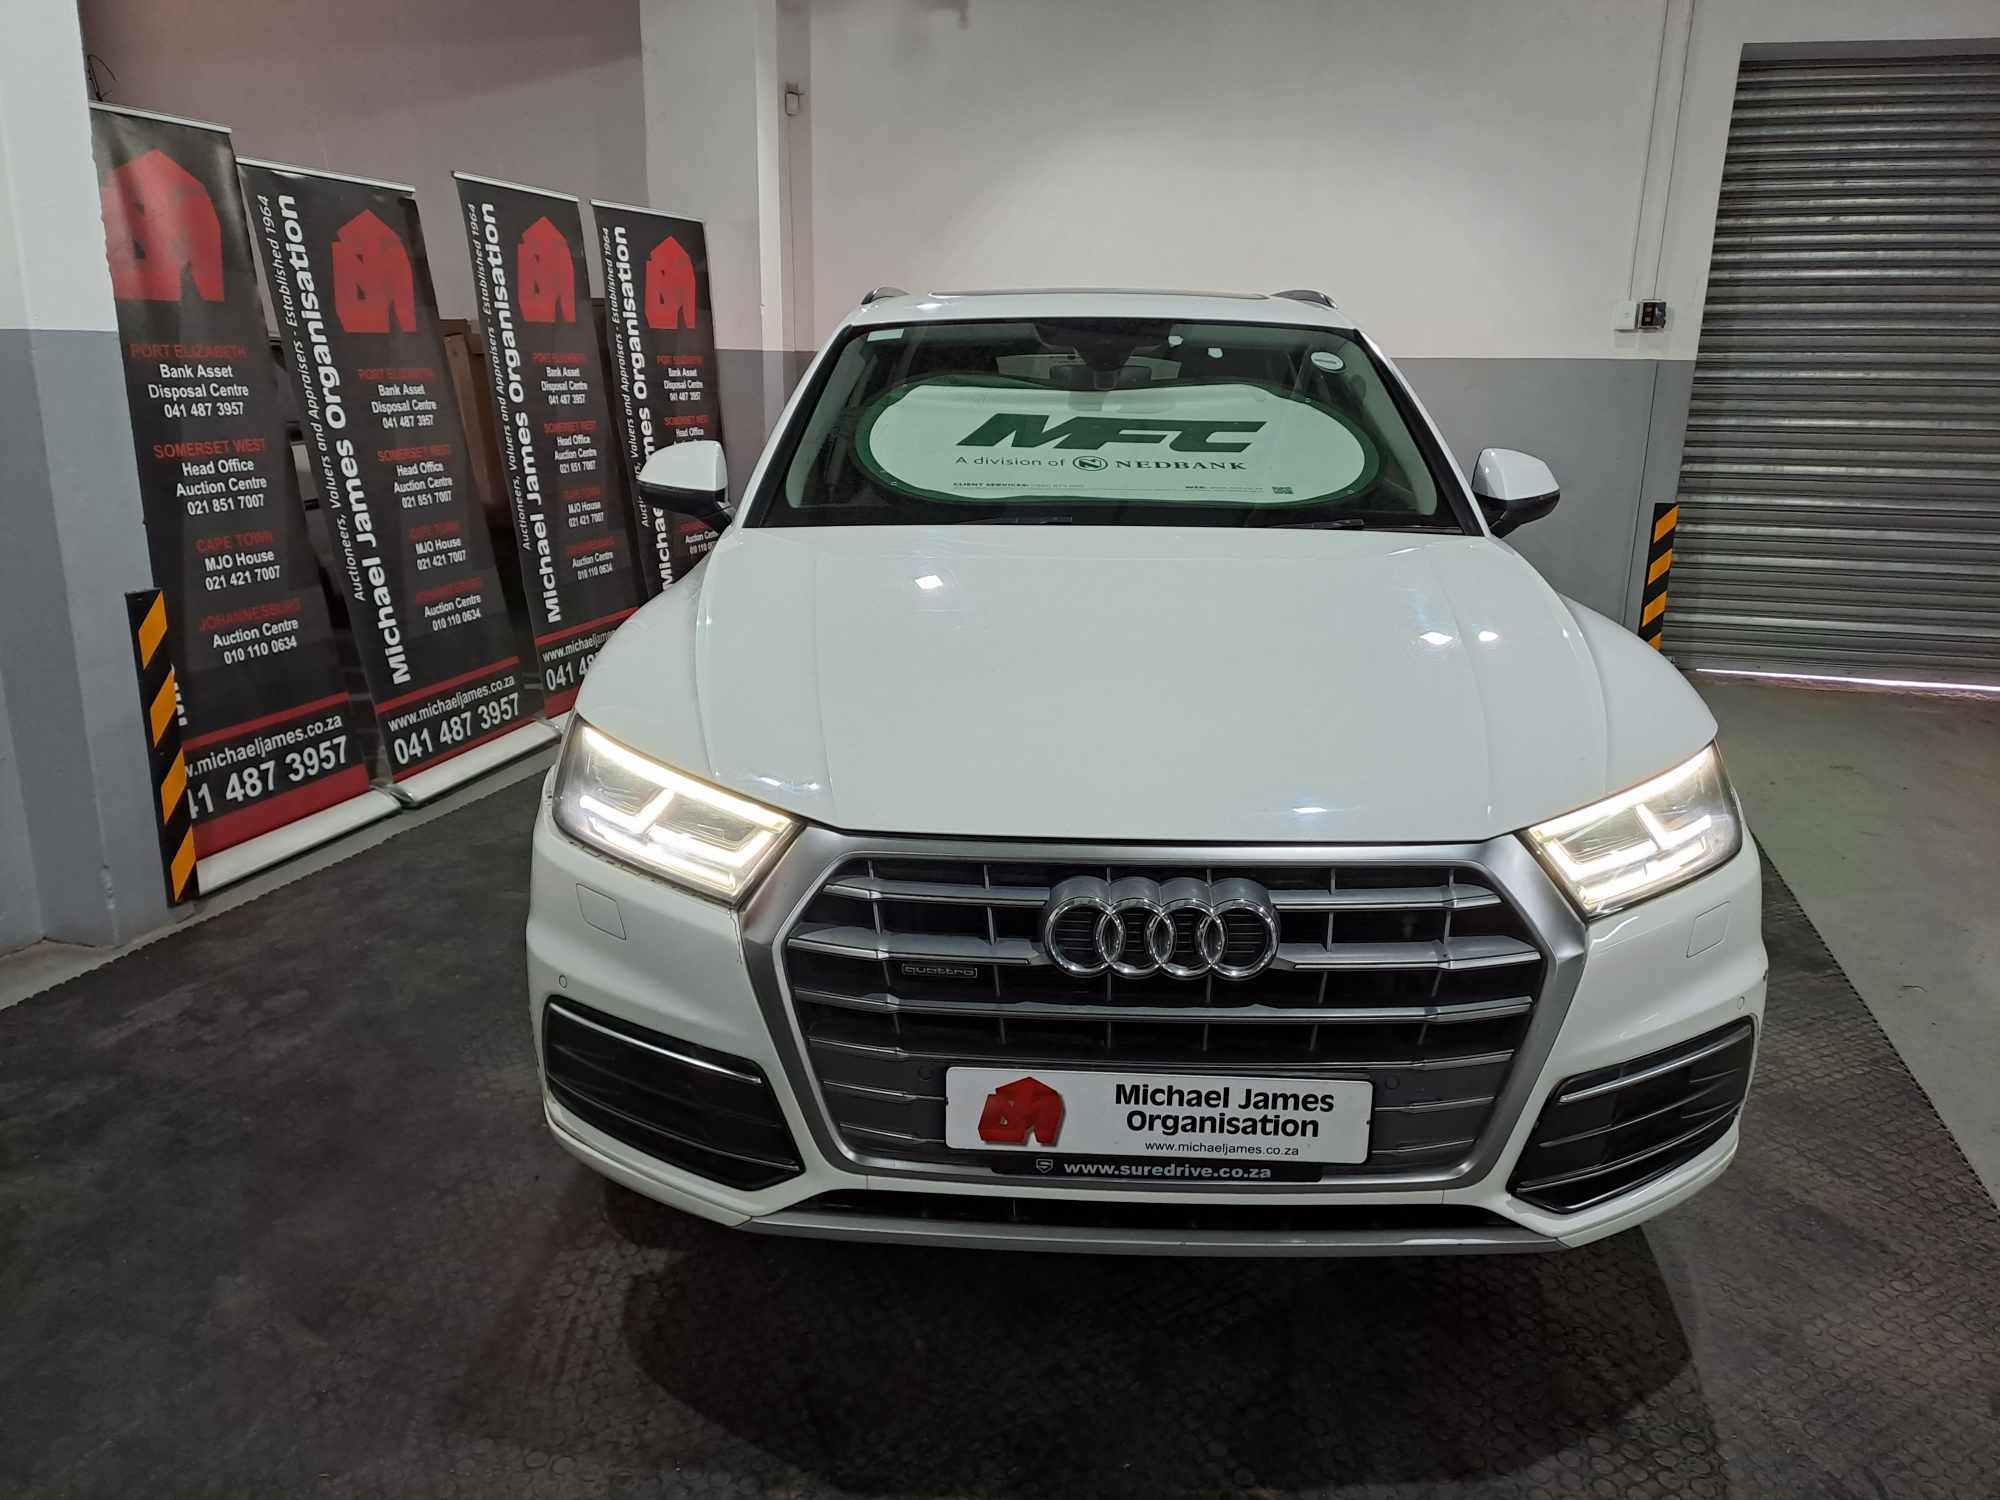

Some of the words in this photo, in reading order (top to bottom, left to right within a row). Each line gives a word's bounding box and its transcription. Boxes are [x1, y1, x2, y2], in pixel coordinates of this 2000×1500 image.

[257, 194, 277, 234] 1964
[468, 203, 480, 236] 1964
[267, 238, 298, 327] Established
[278, 195, 346, 429] Organisation
[481, 203, 524, 403] Organisation
[614, 226, 648, 400] Organisation
[159, 363, 194, 378] Bank
[197, 364, 233, 378] Asset
[293, 340, 320, 420] Appraisers
[148, 384, 207, 401] Disposal
[210, 383, 249, 397] Centre
[378, 384, 401, 396] Bank
[403, 383, 425, 395] Asset
[164, 403, 187, 418] 041
[191, 402, 212, 416] 487
[217, 401, 244, 415] 3957
[371, 400, 410, 415] Disposal
[411, 399, 437, 410] Centre
[497, 396, 509, 421] and
[622, 394, 633, 415] and
[382, 416, 398, 429] 041
[956, 413, 1267, 452] MFC
[153, 440, 229, 458] SOMERSET
[233, 438, 265, 453] WEST
[310, 422, 328, 452] and
[504, 425, 518, 471] Valuers
[625, 417, 640, 458] Valuers
[182, 461, 215, 476] Head
[218, 458, 255, 473] Office
[396, 463, 418, 476] Head
[420, 461, 444, 474] Office
[515, 412, 542, 506] James
[955, 456, 968, 464] A
[974, 456, 1042, 466] division
[1048, 457, 1066, 467] of
[1116, 461, 1247, 470] NEDBANK
[176, 481, 225, 497] Auction
[229, 477, 268, 492] Centre
[321, 456, 341, 509] Valuers
[335, 439, 377, 547] James
[394, 480, 426, 493] Auction
[427, 476, 453, 488] Centre
[187, 500, 209, 515] 021
[213, 497, 235, 512] 851
[237, 494, 265, 509] 7007
[401, 495, 417, 508] 021
[512, 475, 531, 550] Auctioneers,
[336, 514, 366, 602] Auctioneers,
[416, 541, 433, 554] MJO
[434, 538, 462, 550] House
[417, 558, 431, 570] 021
[447, 550, 466, 564] 7007
[653, 507, 673, 590] Michae
[205, 555, 233, 571] MJO
[236, 551, 275, 566] House
[530, 513, 561, 623] Michael
[205, 575, 226, 591] 021
[230, 570, 252, 586] 421
[254, 565, 280, 581] 7007
[424, 601, 454, 617] Auction
[455, 594, 481, 608] Centre
[213, 628, 260, 648] Auction
[262, 619, 299, 636] Centre
[362, 556, 411, 686] Michael
[432, 617, 447, 631] 010
[223, 648, 245, 664] 010
[247, 642, 268, 659] 110
[271, 635, 298, 653] 0634
[546, 662, 574, 691] 041
[388, 675, 515, 732] www.michaeljames.co.za
[394, 727, 433, 765] 041
[439, 711, 472, 745] 487
[478, 692, 519, 729] 3957
[225, 760, 276, 802] 487
[285, 735, 347, 782] 3957
[904, 966, 975, 976] quattro
[1115, 1083, 1230, 1108] Michael
[1238, 1088, 1334, 1112] James
[1126, 1110, 1319, 1137] Organisation
[1145, 1141, 1299, 1157] www.michaeljames.co.za
[1063, 1162, 1271, 1179] www.suredrive.co.za
